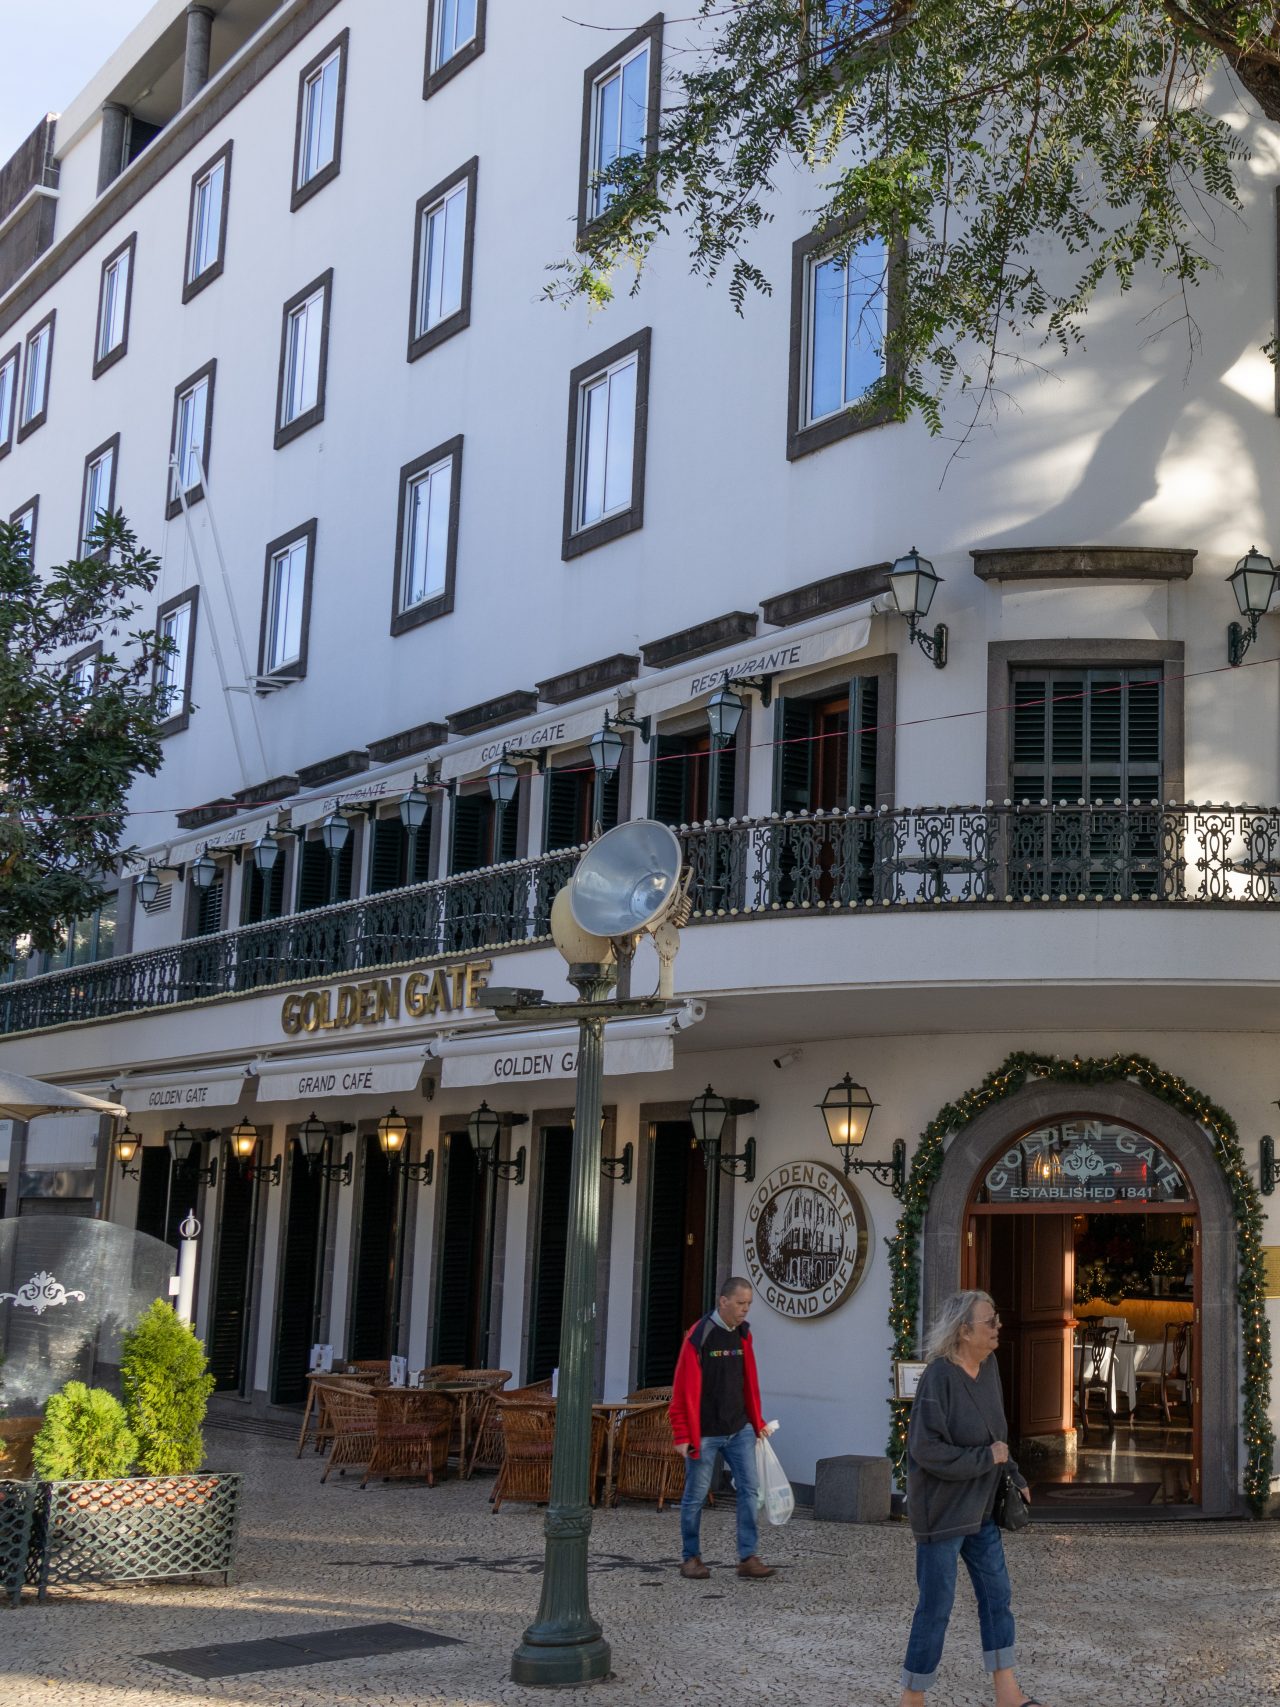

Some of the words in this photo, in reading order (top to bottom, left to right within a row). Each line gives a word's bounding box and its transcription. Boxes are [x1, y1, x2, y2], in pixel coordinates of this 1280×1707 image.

[690, 646, 801, 697] RESTAURANTE
[531, 723, 565, 745] GATE
[281, 977, 401, 1035] GOLDEN
[404, 960, 493, 1019] GATE
[298, 1074, 336, 1094] GRAND
[343, 1068, 373, 1090] CAFÉ
[494, 1053, 554, 1078] GOLDEN
[149, 1089, 183, 1107] GOLDEN
[186, 1087, 209, 1103] GATE
[985, 1121, 1103, 1192] GOLDEN
[1116, 1132, 1185, 1194] GATE
[749, 1165, 814, 1223] GOLDEN
[817, 1171, 856, 1232] GATE
[1010, 1187, 1115, 1198] ESTABLISHED
[1119, 1187, 1153, 1198] 1841
[744, 1237, 764, 1286] 1841
[765, 1286, 819, 1315] GRAND
